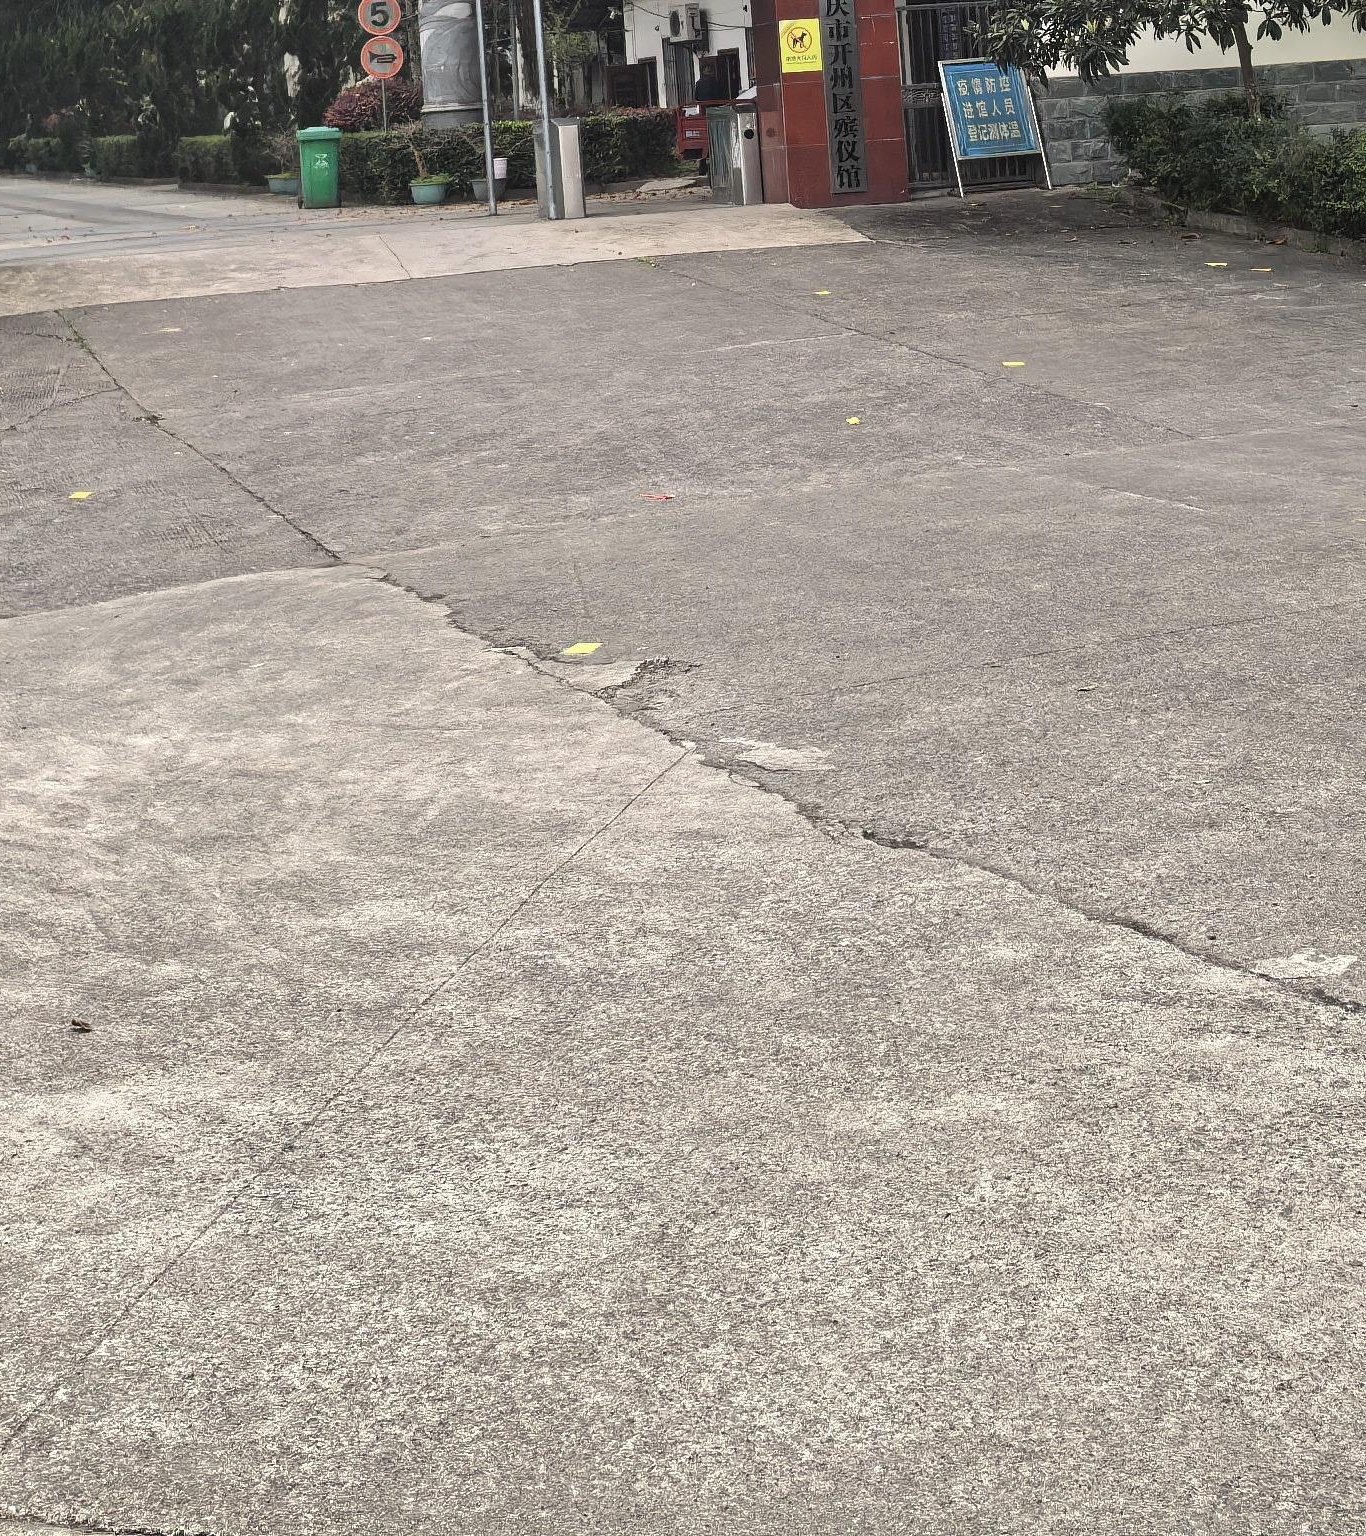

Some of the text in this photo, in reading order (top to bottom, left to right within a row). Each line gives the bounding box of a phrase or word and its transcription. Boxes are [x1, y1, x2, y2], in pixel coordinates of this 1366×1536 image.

[371, 2, 390, 26] 5
[957, 75, 1012, 96] 疫情防控
[962, 98, 1015, 119] 进馆人员
[968, 121, 1021, 142] 登记测体温
